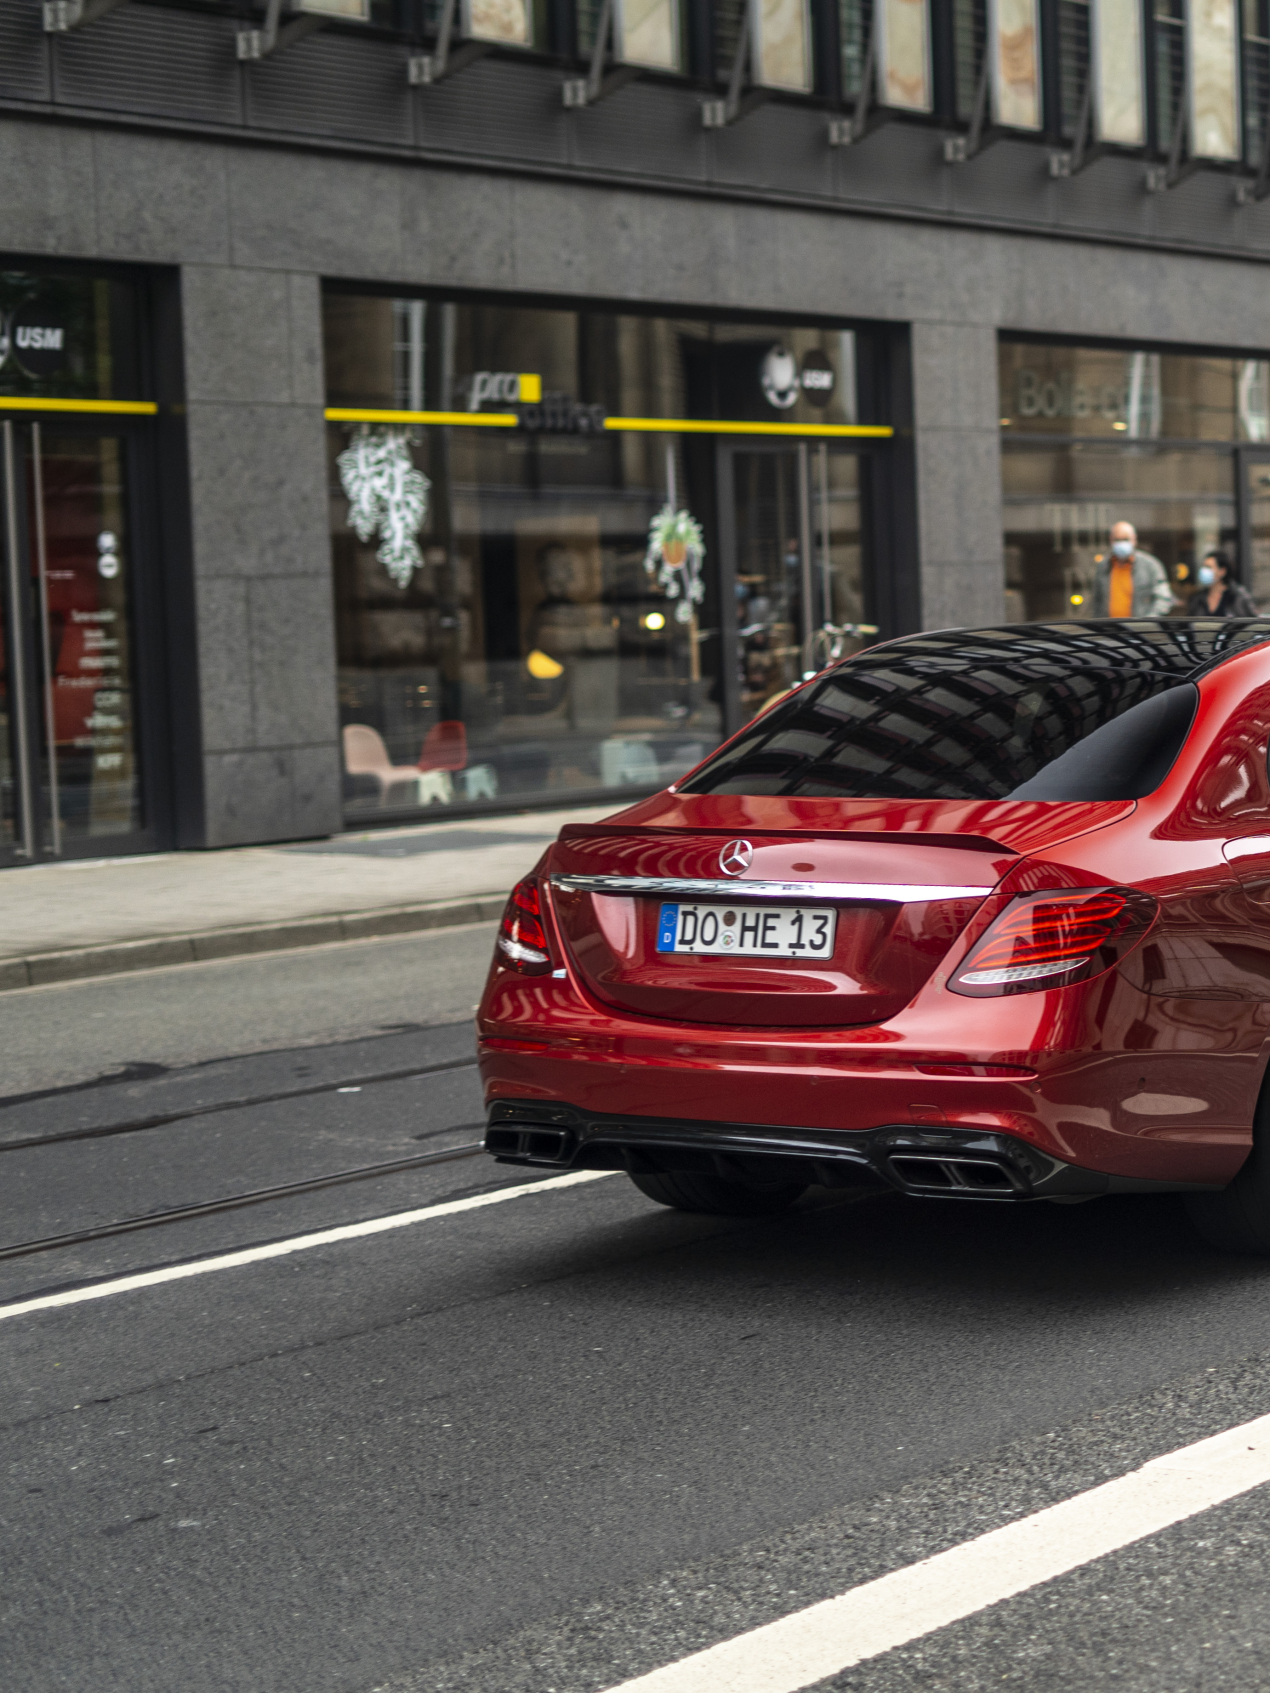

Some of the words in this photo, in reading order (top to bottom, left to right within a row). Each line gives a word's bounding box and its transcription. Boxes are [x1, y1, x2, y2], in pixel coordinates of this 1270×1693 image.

[16, 325, 64, 350] USM
[470, 371, 519, 413] pro
[663, 932, 672, 943] D
[678, 911, 719, 947] DO
[739, 912, 781, 949] HE
[788, 914, 829, 951] 13
